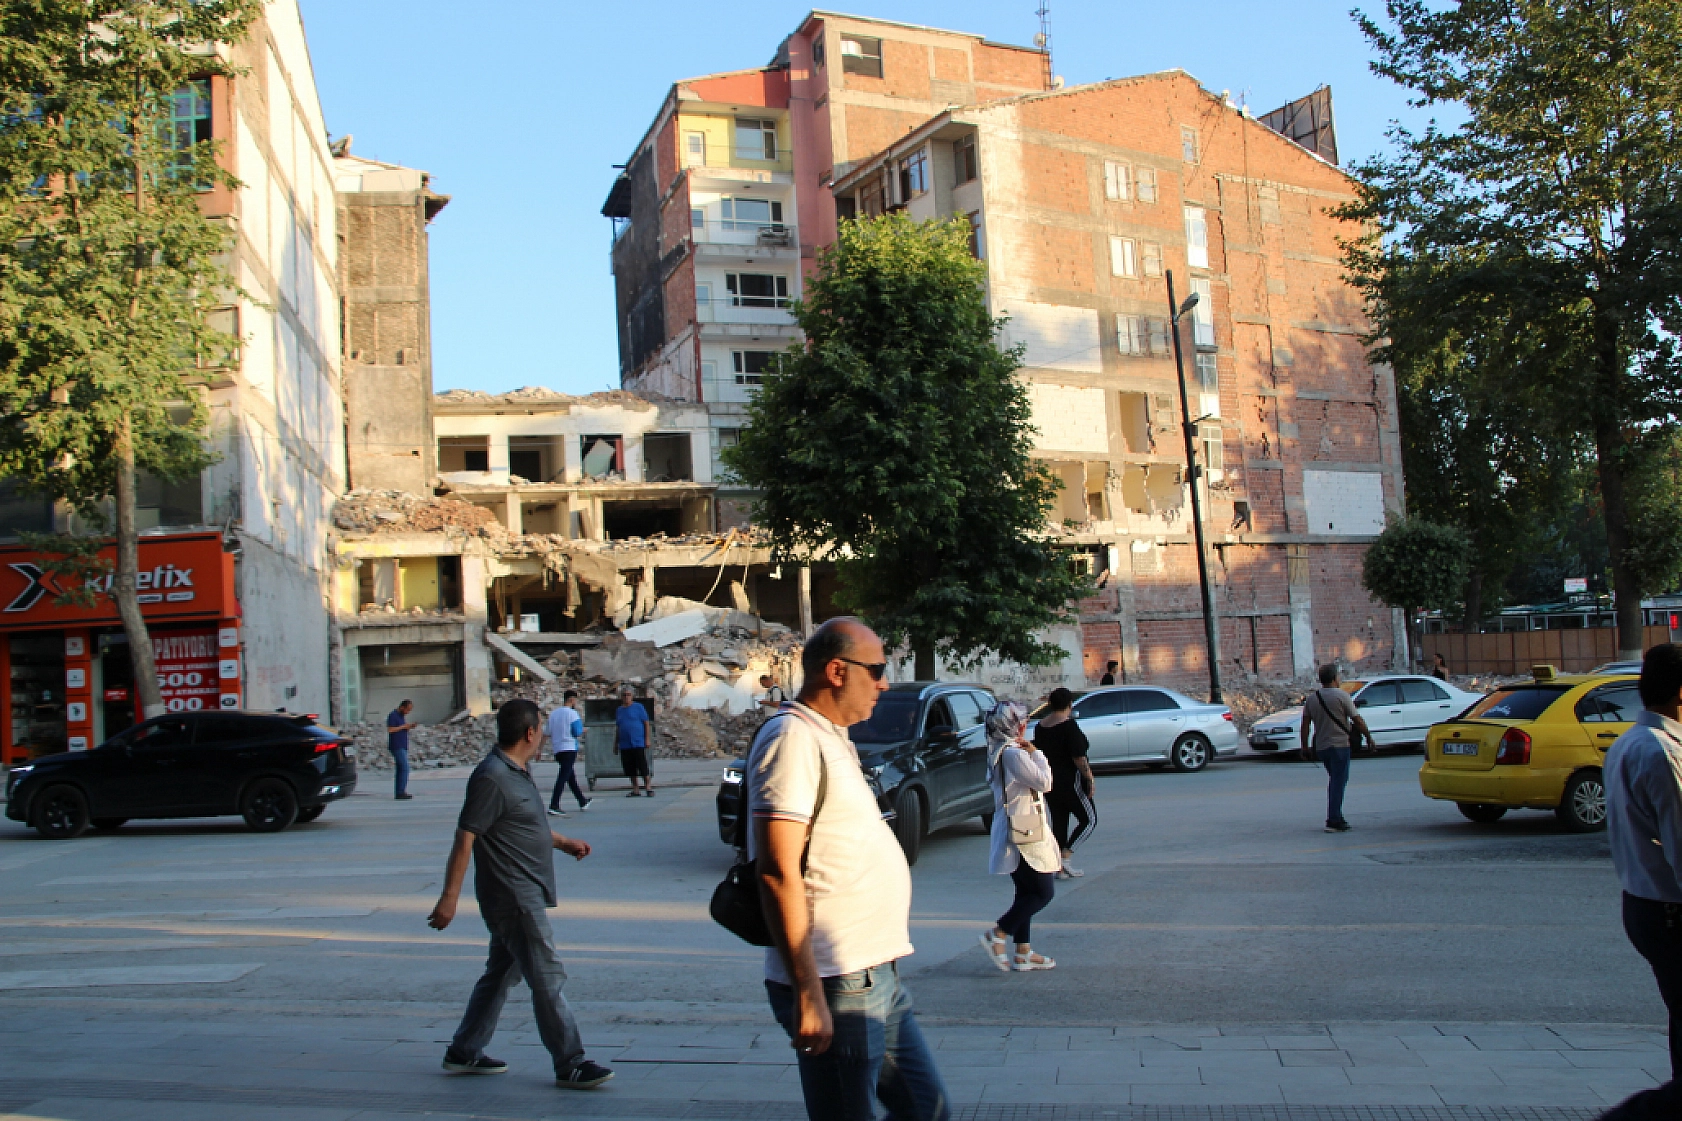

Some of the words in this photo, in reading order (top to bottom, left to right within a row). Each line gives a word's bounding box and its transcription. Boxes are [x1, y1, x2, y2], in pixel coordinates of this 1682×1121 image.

[84, 564, 194, 592] kietix
[152, 635, 219, 659] PATIYORU
[165, 698, 203, 711] 00
